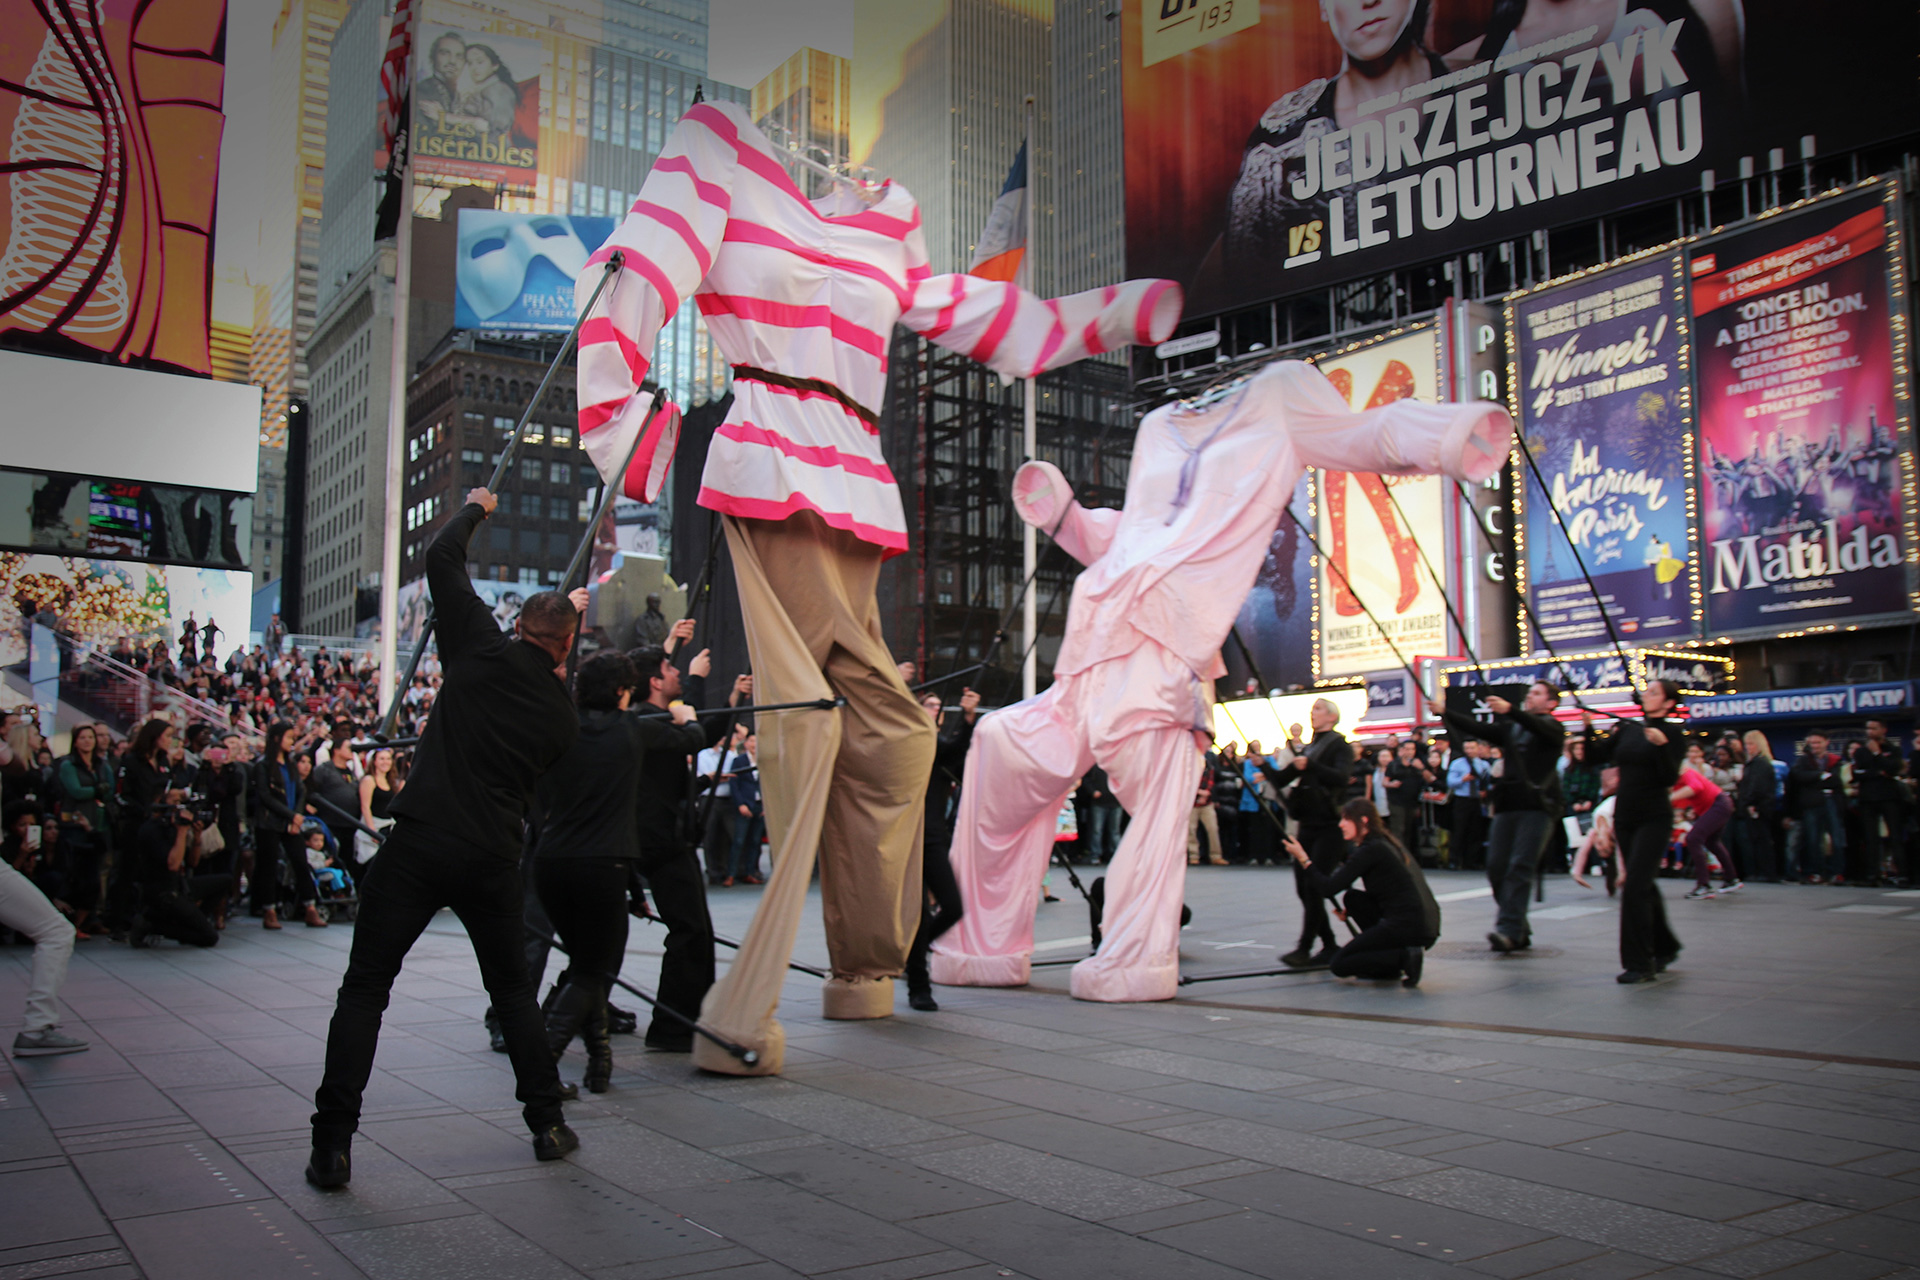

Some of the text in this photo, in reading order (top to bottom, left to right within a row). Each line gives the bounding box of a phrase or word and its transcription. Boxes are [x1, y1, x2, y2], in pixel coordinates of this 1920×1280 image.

[1198, 0, 1233, 32] 193
[437, 110, 477, 138] Les
[1291, 18, 1690, 200] JEDRZEJCZYK
[1288, 91, 1703, 257] VS LETOURNEAU
[1726, 235, 1838, 284] TIME Magazine's
[1736, 274, 1773, 297] Show
[1773, 266, 1789, 283] of
[1789, 260, 1813, 277] the
[1813, 243, 1851, 266] Year!
[545, 308, 565, 318] THE
[1527, 274, 1664, 328] THE MOST AWARD-WINNING
[1802, 281, 1830, 302] IN
[1532, 290, 1662, 341] MUSICAL OF THE SEASON!
[1715, 291, 1868, 348] A BLUE MOON.
[1738, 319, 1839, 355] A SHOW COMES
[1529, 314, 1669, 390] Winner!
[1730, 329, 1850, 369] OUT BLAZING AND
[1739, 346, 1842, 380] RESTORES YOUR
[1531, 363, 1669, 419] 4 2015 TONY AWARDS
[1725, 354, 1862, 397] FAITH IN BROADWAY.
[1762, 378, 1823, 401] MATILDA
[1744, 406, 1758, 419] IS
[1758, 397, 1794, 416] THAT
[1568, 438, 1602, 484] An
[1549, 467, 1669, 516] American
[1567, 502, 1645, 549] Paris
[1708, 518, 1905, 595] Matilda
[1772, 578, 1837, 595] THE MUSICAL
[1403, 613, 1442, 632] AWARDS
[1690, 689, 1905, 718] CHANGE MONEY ATM
